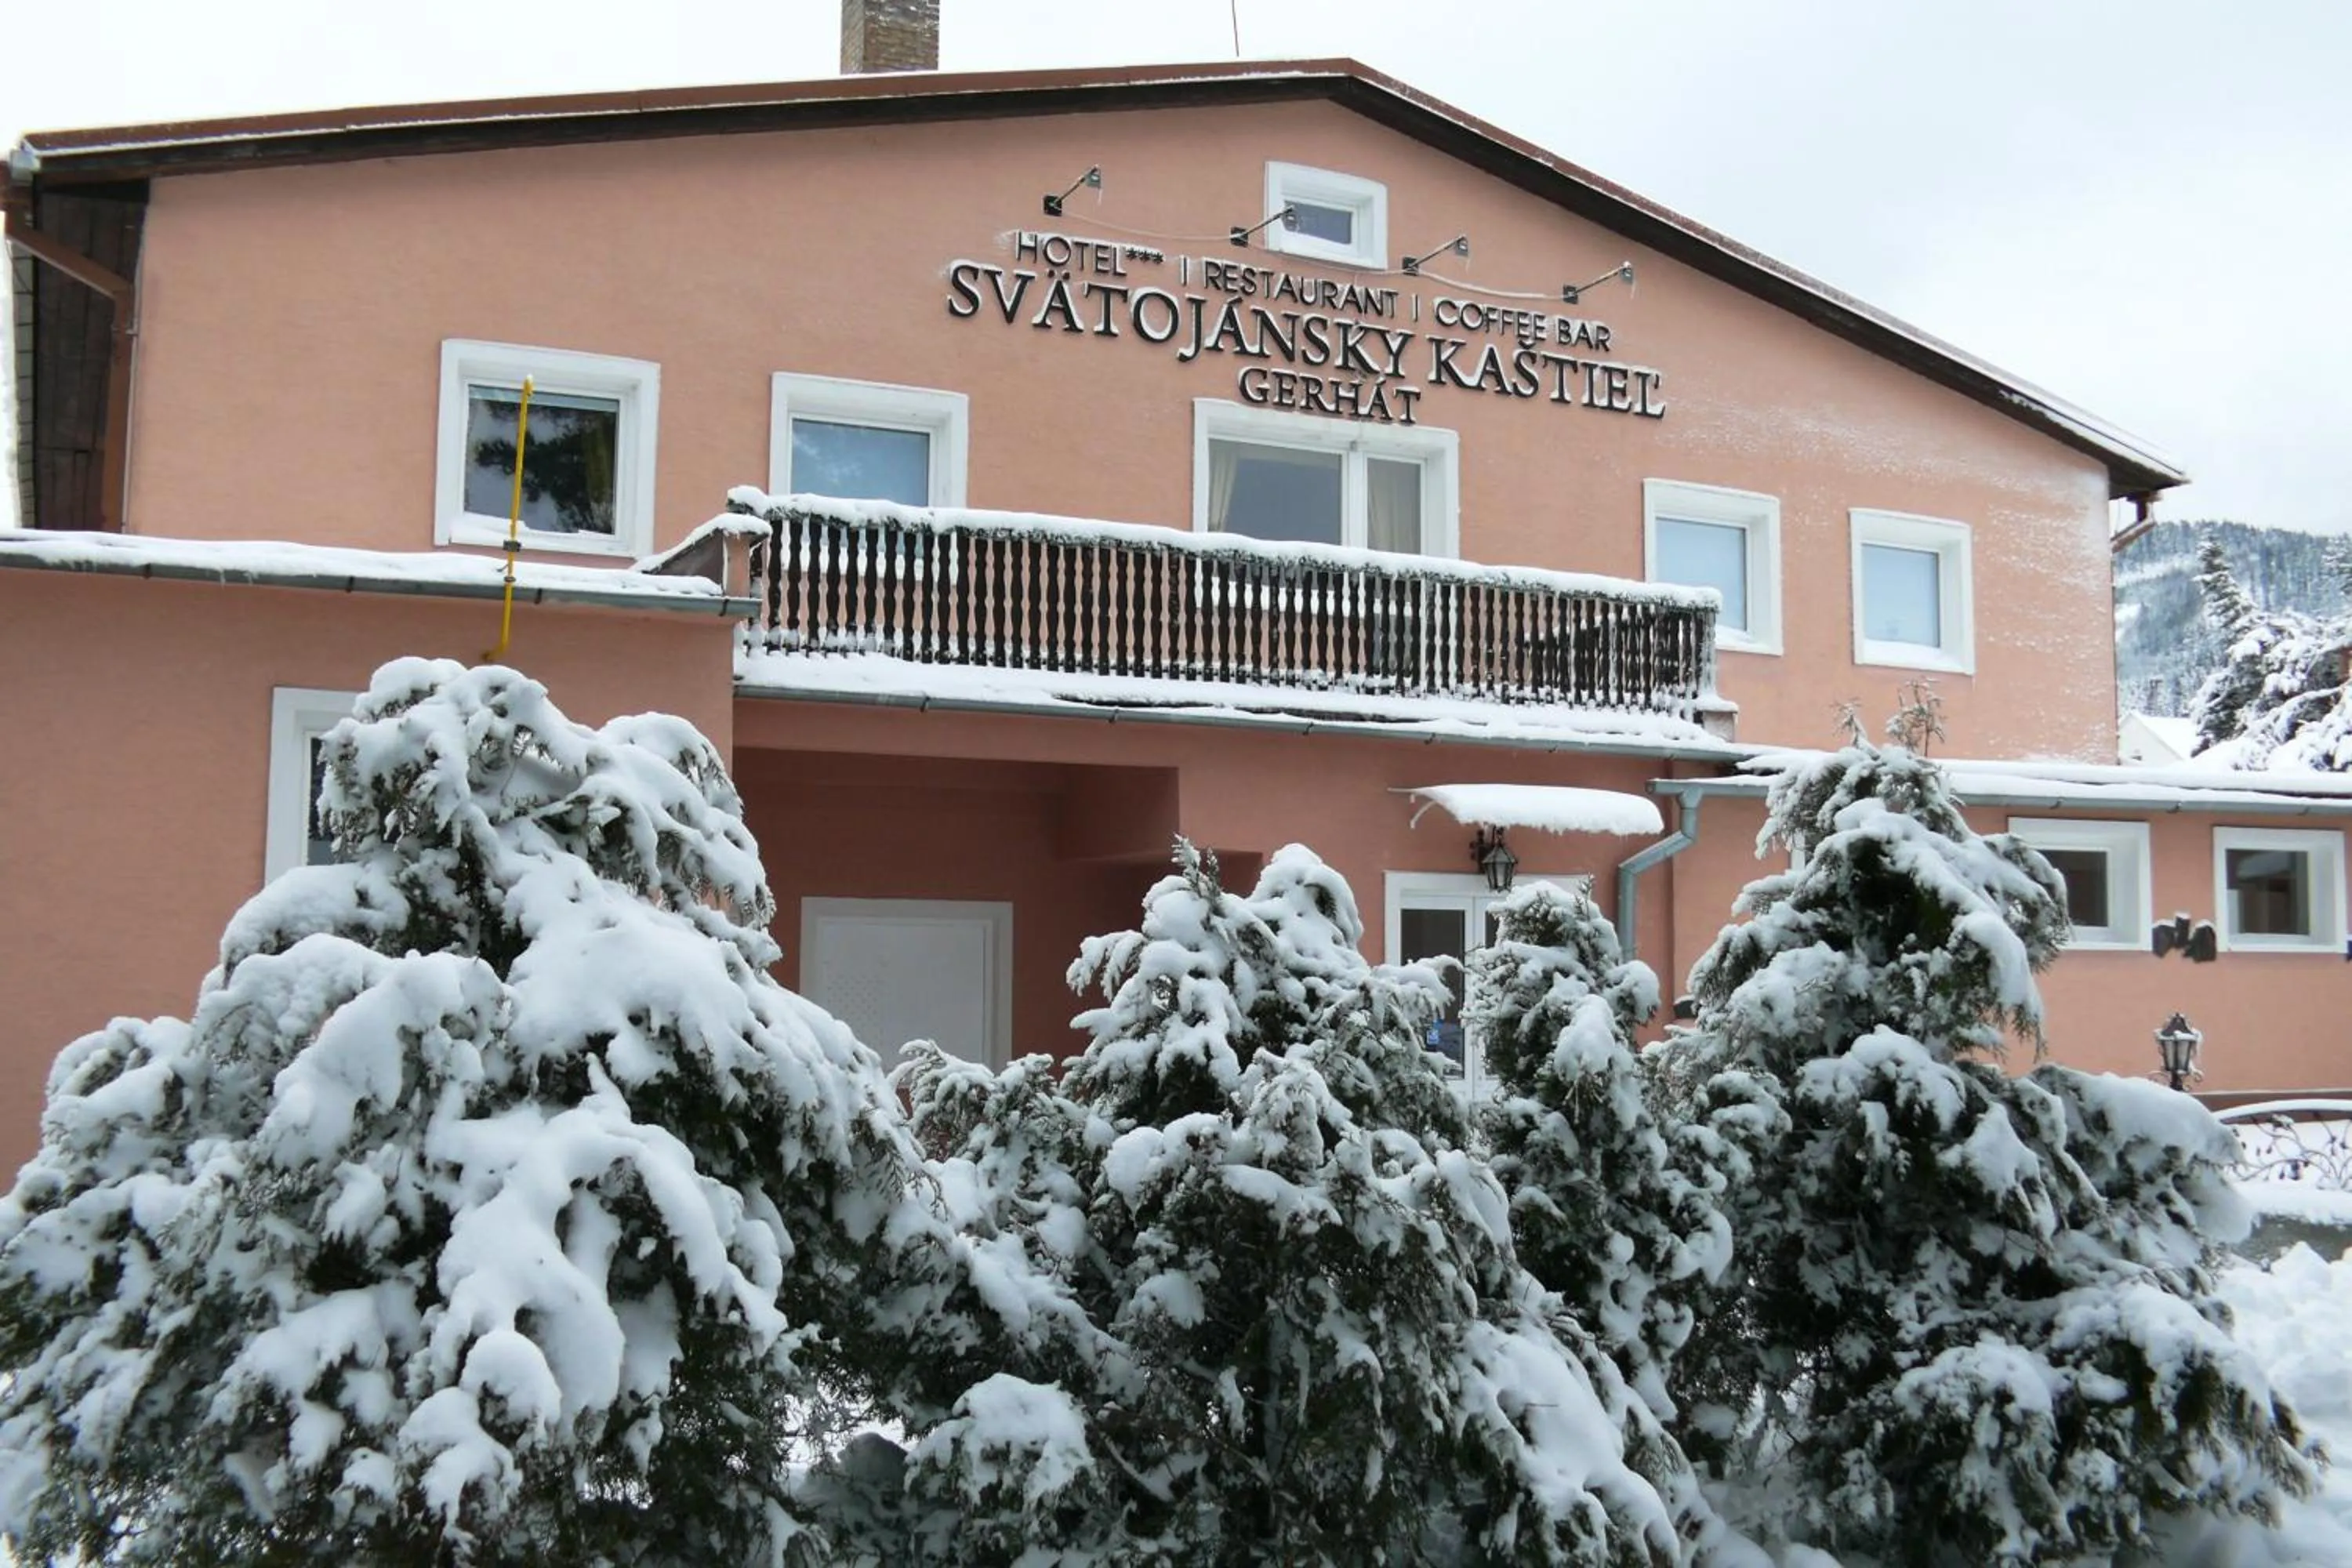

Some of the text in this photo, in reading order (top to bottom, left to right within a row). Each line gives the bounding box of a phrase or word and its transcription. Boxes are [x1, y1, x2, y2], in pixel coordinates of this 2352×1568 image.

[1203, 259, 1399, 319] RESTAURANT
[1435, 299, 1546, 341] COFFEE
[1558, 318, 1612, 352] BAR
[1238, 367, 1421, 423] GERHÁT
